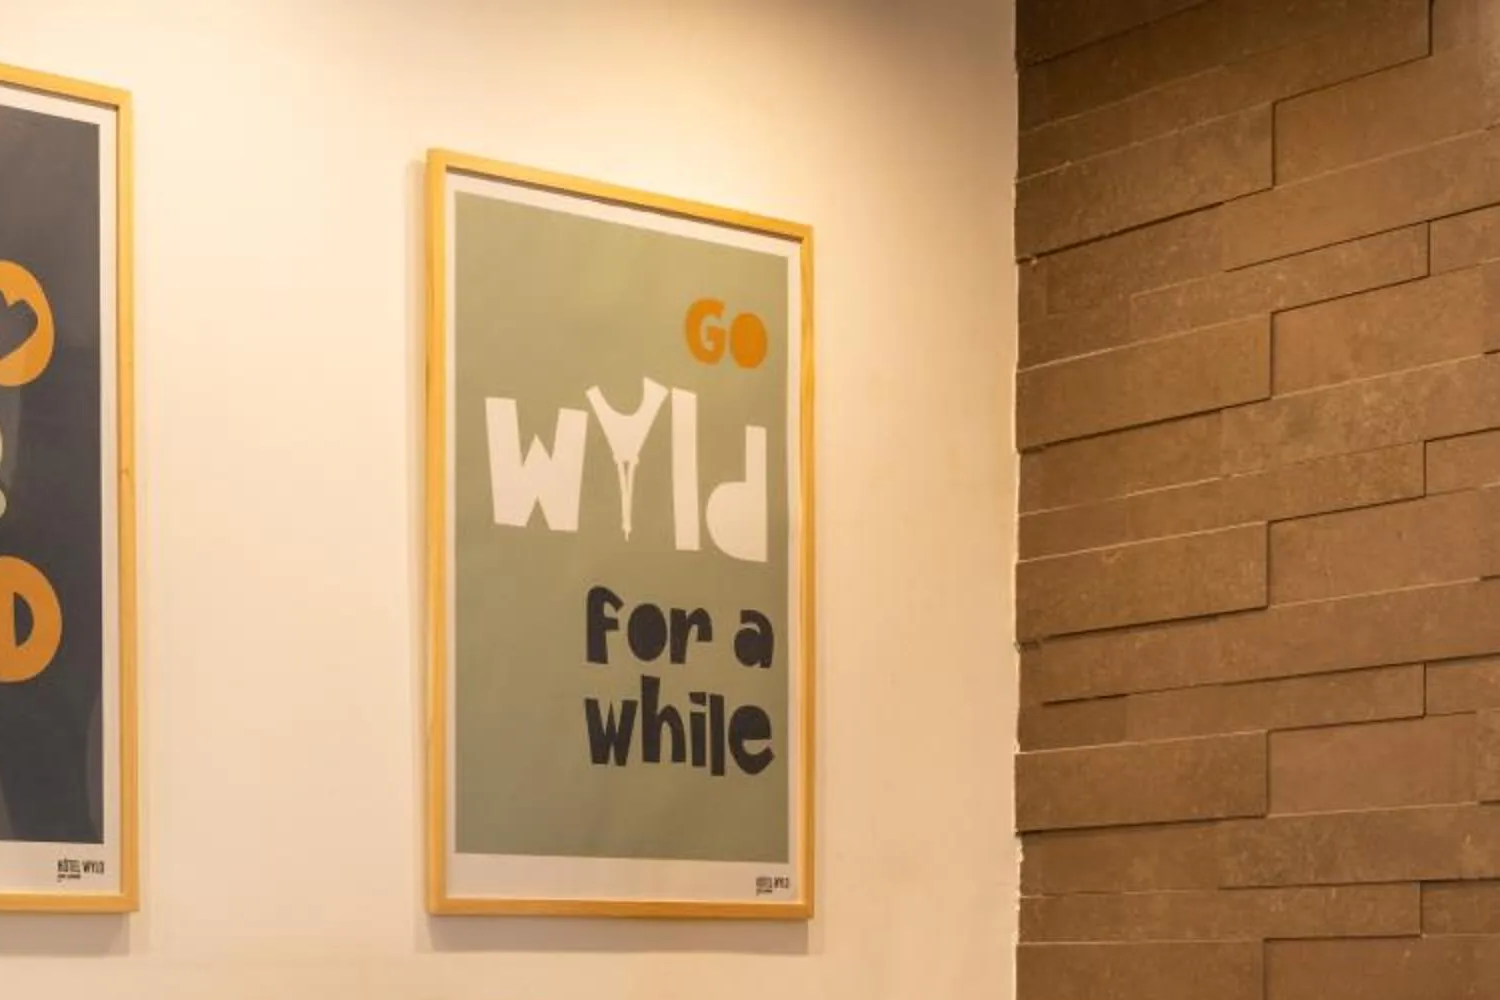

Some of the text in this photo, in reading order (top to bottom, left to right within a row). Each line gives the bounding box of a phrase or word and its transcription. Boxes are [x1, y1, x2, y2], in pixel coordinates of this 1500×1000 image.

[684, 298, 768, 369] GO
[585, 585, 774, 669] for a
[584, 674, 775, 777] while
